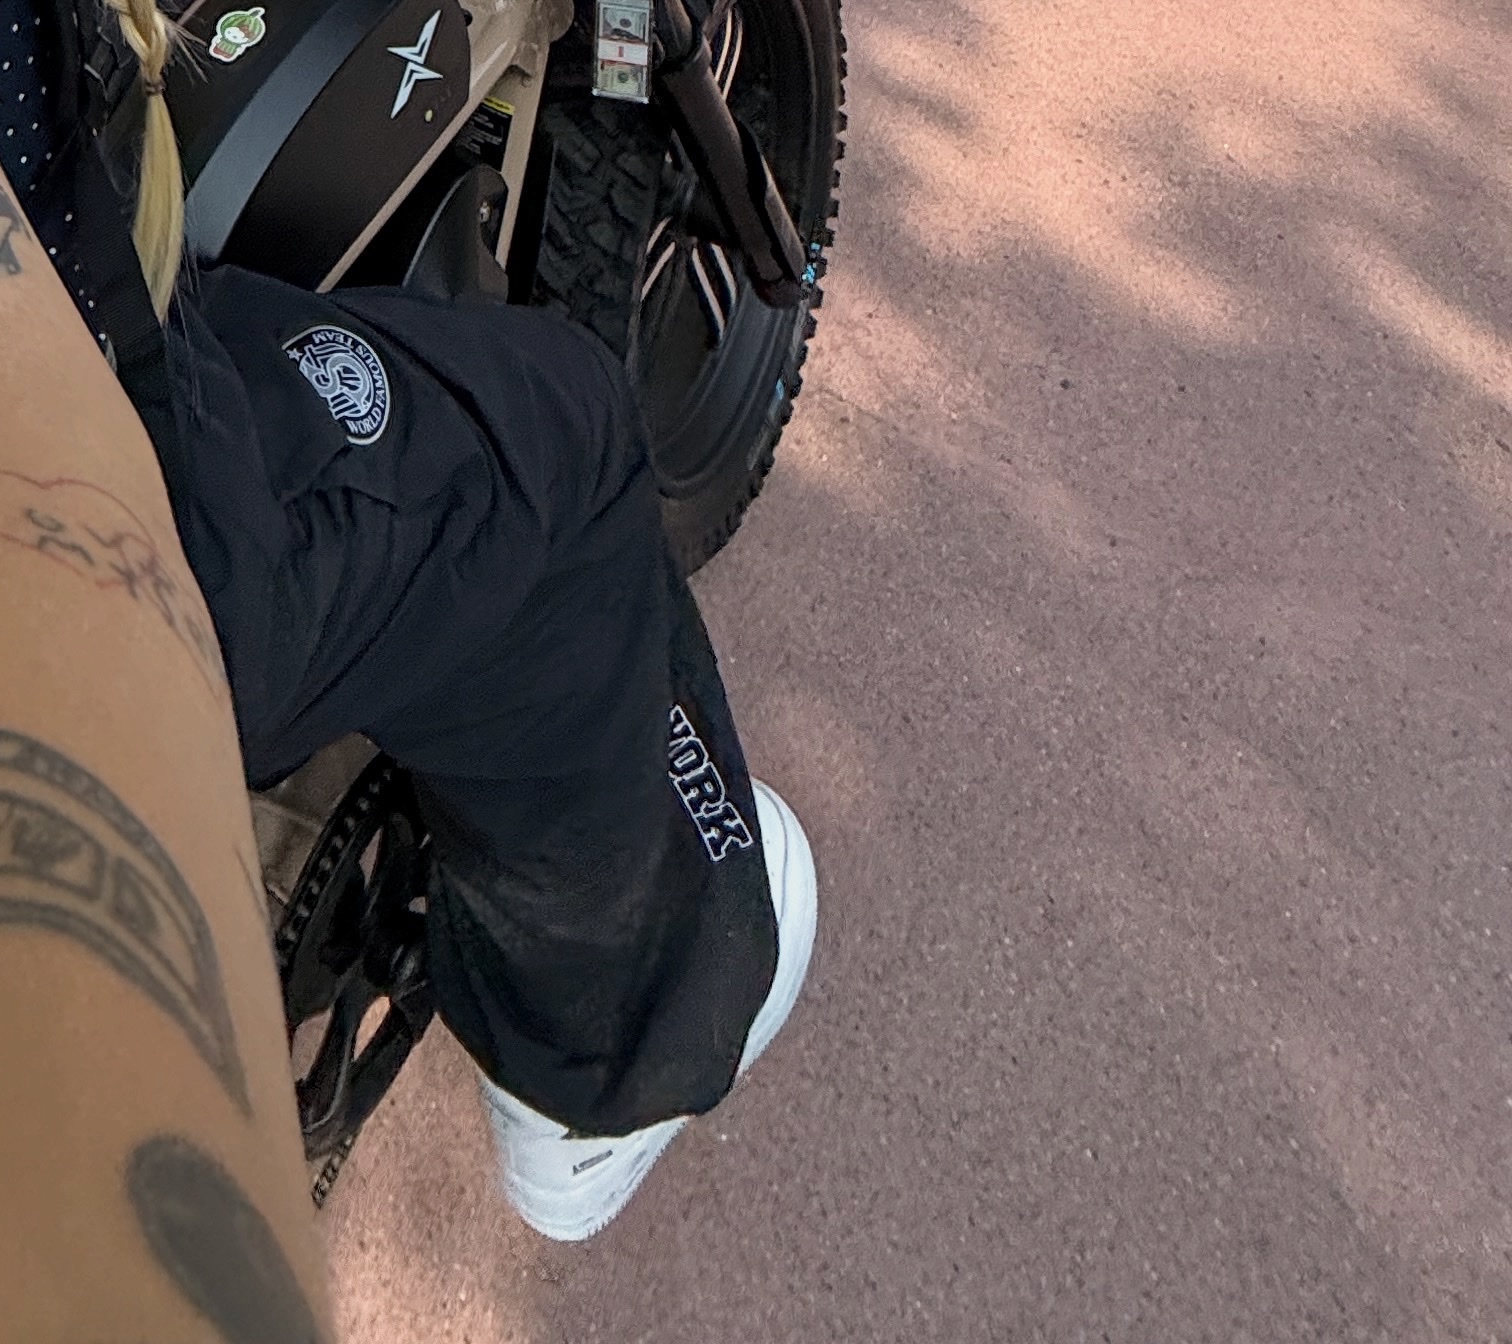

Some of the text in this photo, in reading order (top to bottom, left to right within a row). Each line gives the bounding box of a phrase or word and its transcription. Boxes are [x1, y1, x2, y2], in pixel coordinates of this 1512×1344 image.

[312, 331, 354, 347] TEAM
[356, 345, 385, 407] FAMOUS
[346, 409, 383, 434] WORLD
